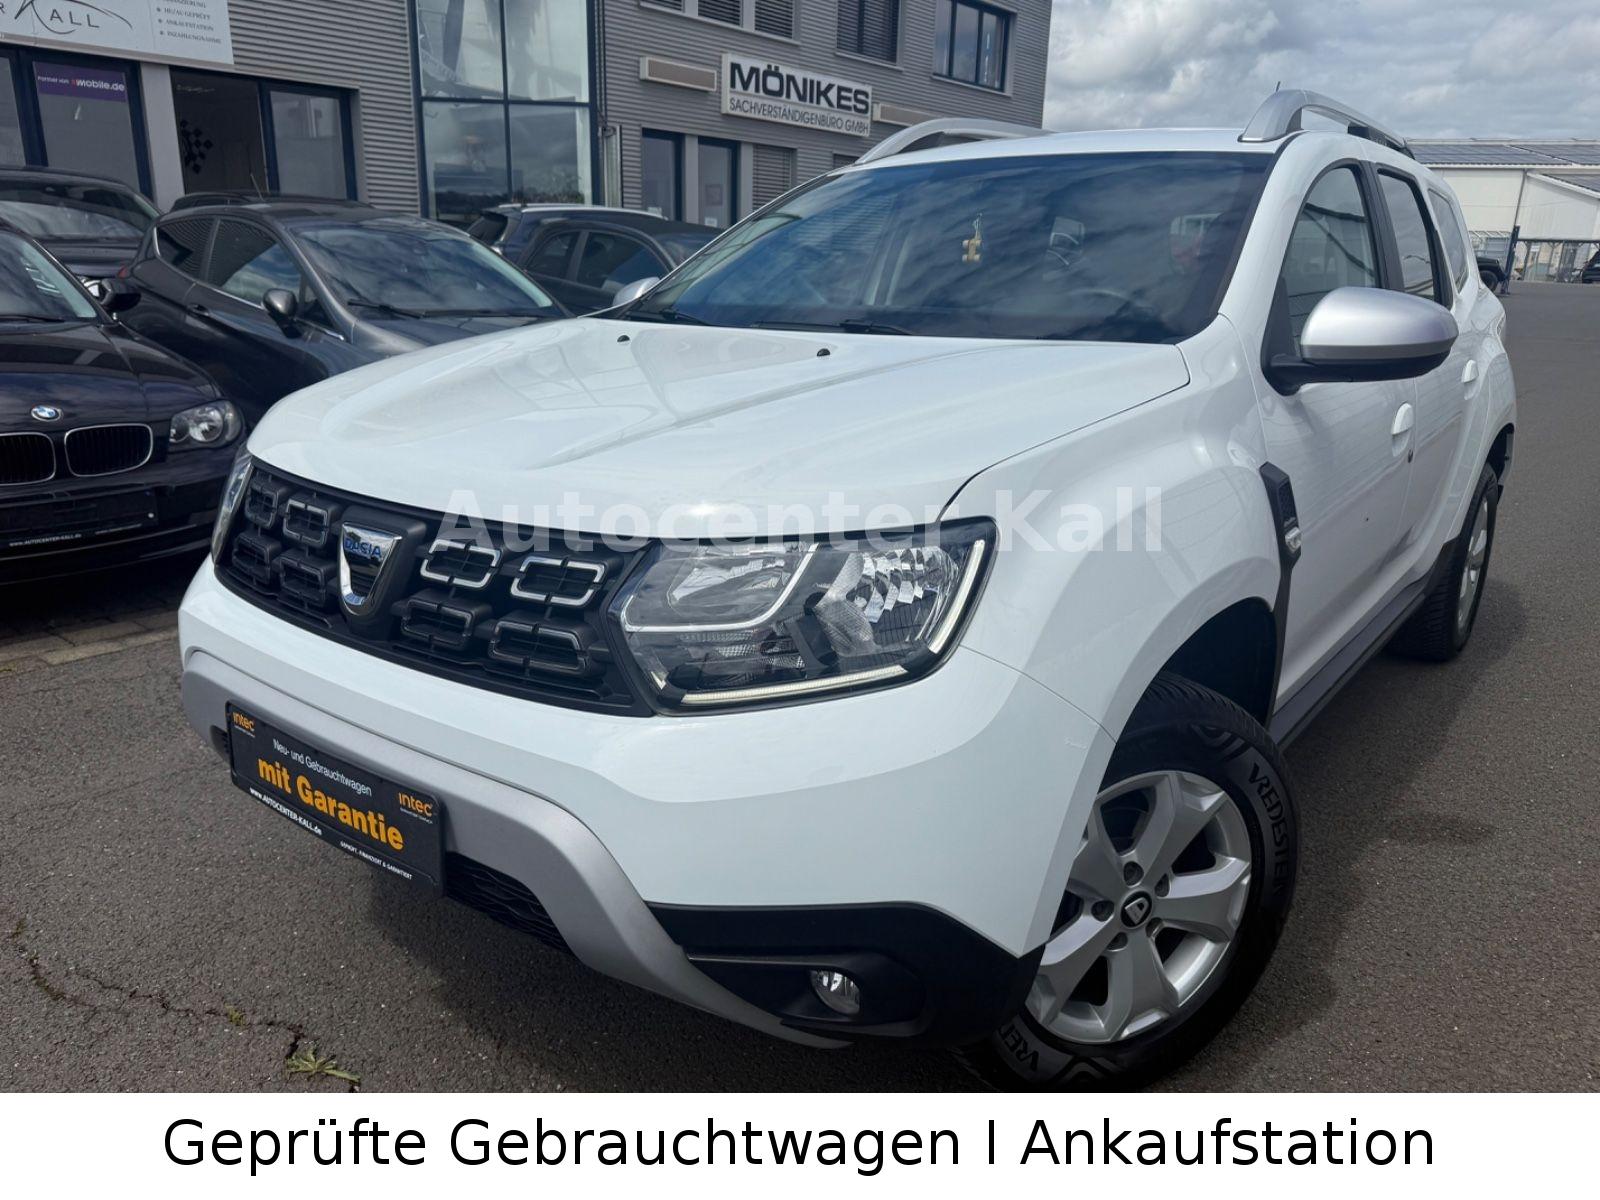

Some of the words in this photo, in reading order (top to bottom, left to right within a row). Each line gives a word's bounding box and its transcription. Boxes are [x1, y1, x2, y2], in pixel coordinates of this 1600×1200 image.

[730, 62, 870, 115] MÖNIKES
[273, 739, 290, 756] Neu-
[291, 750, 304, 764] und
[305, 756, 372, 797] Gebrauchtwagen
[258, 758, 292, 794] mit
[296, 774, 404, 851] Garantie
